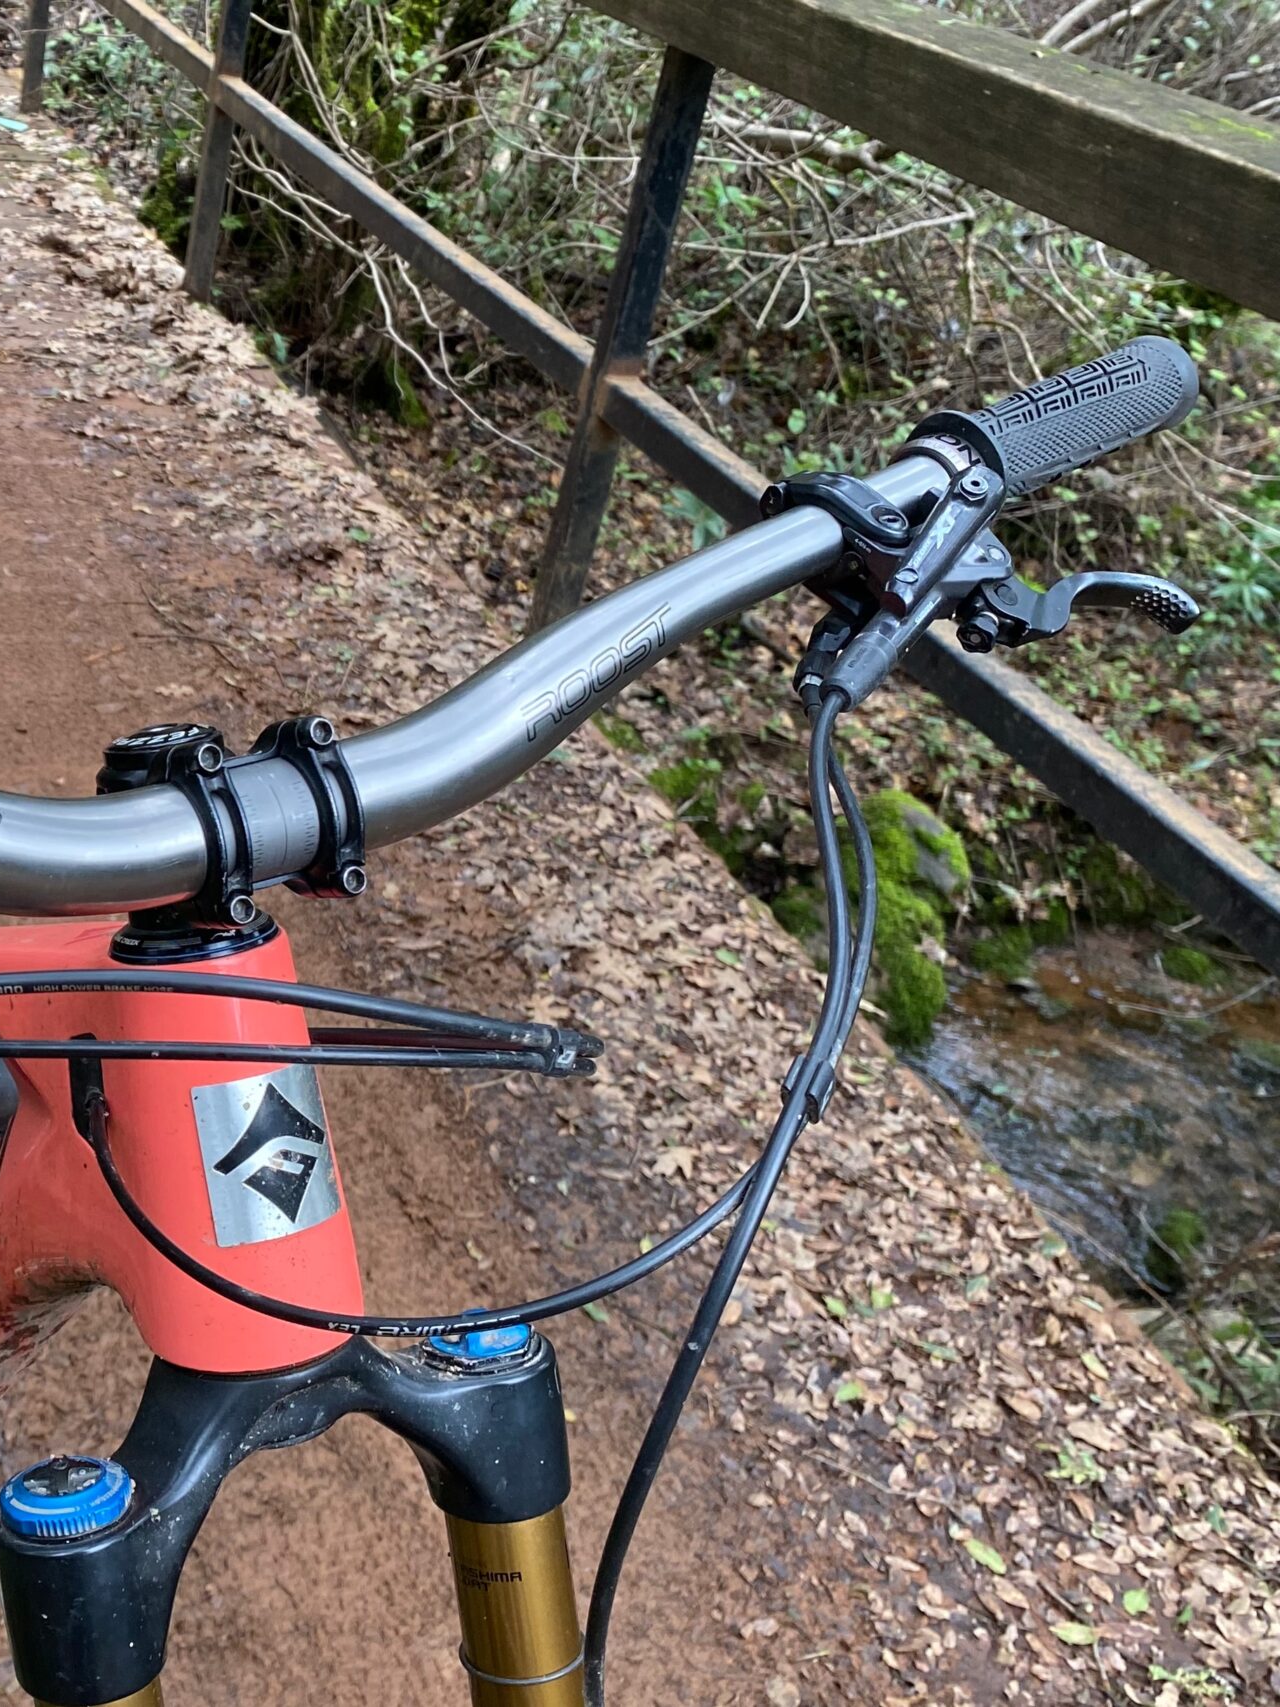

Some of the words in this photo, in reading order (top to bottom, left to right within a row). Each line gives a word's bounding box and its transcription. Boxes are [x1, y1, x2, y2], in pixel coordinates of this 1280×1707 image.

[520, 602, 672, 742] ROOST
[33, 984, 59, 993] HIGH
[62, 983, 101, 992] POWER
[104, 983, 140, 992] BRAKE
